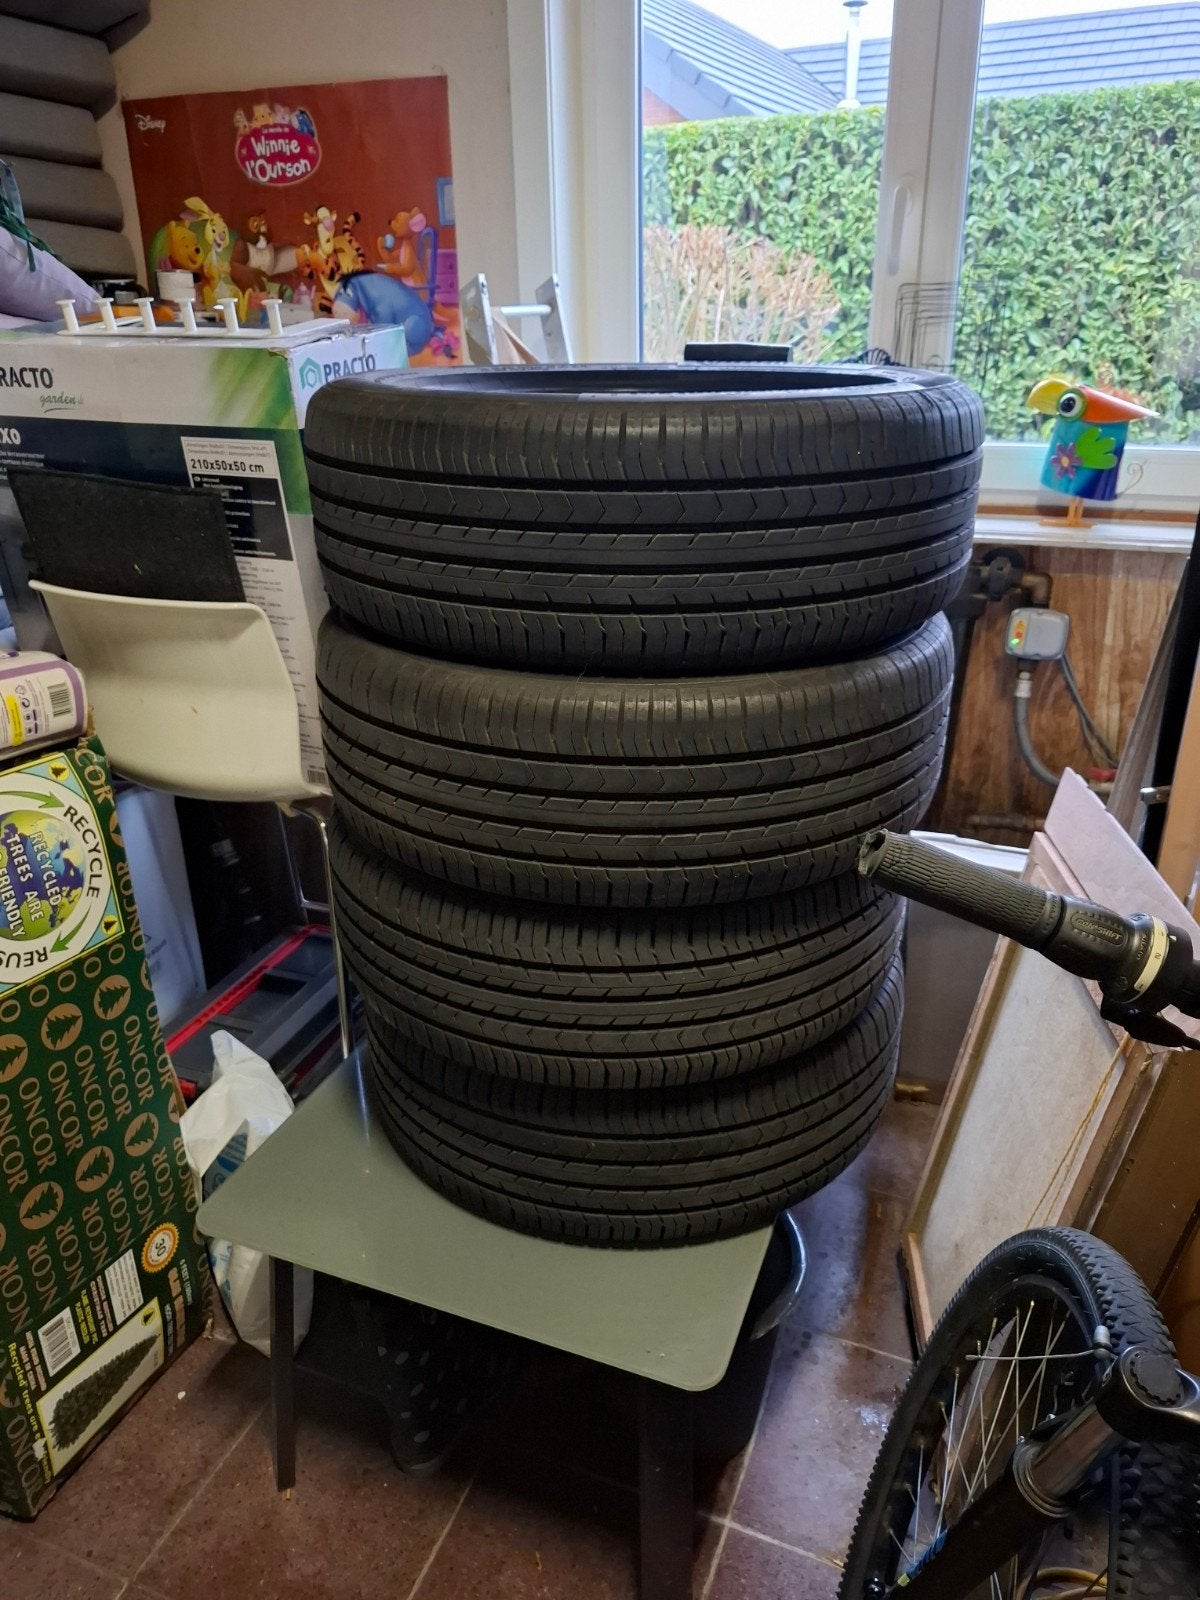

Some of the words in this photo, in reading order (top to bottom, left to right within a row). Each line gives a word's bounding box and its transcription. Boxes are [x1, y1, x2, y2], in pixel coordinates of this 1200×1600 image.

[251, 135, 301, 157] Winnie
[40, 391, 76, 408] garden
[324, 354, 376, 384] PRACTO
[191, 459, 246, 473] 210x50x50
[249, 464, 264, 473] cm
[7, 834, 33, 883] TREES
[25, 890, 44, 922] ARE
[30, 831, 61, 906] RECYCLED
[63, 806, 102, 898] RECYCLE
[74, 1045, 109, 1139] ONCOR
[100, 1029, 132, 1122] ONCOR
[124, 1015, 155, 1105] ONCOR
[19, 1077, 57, 1174] ONCOR
[47, 1060, 84, 1156] ONCOR
[155, 1237, 167, 1258] 30
[22, 1389, 33, 1415] trees
[30, 1415, 39, 1432] are
